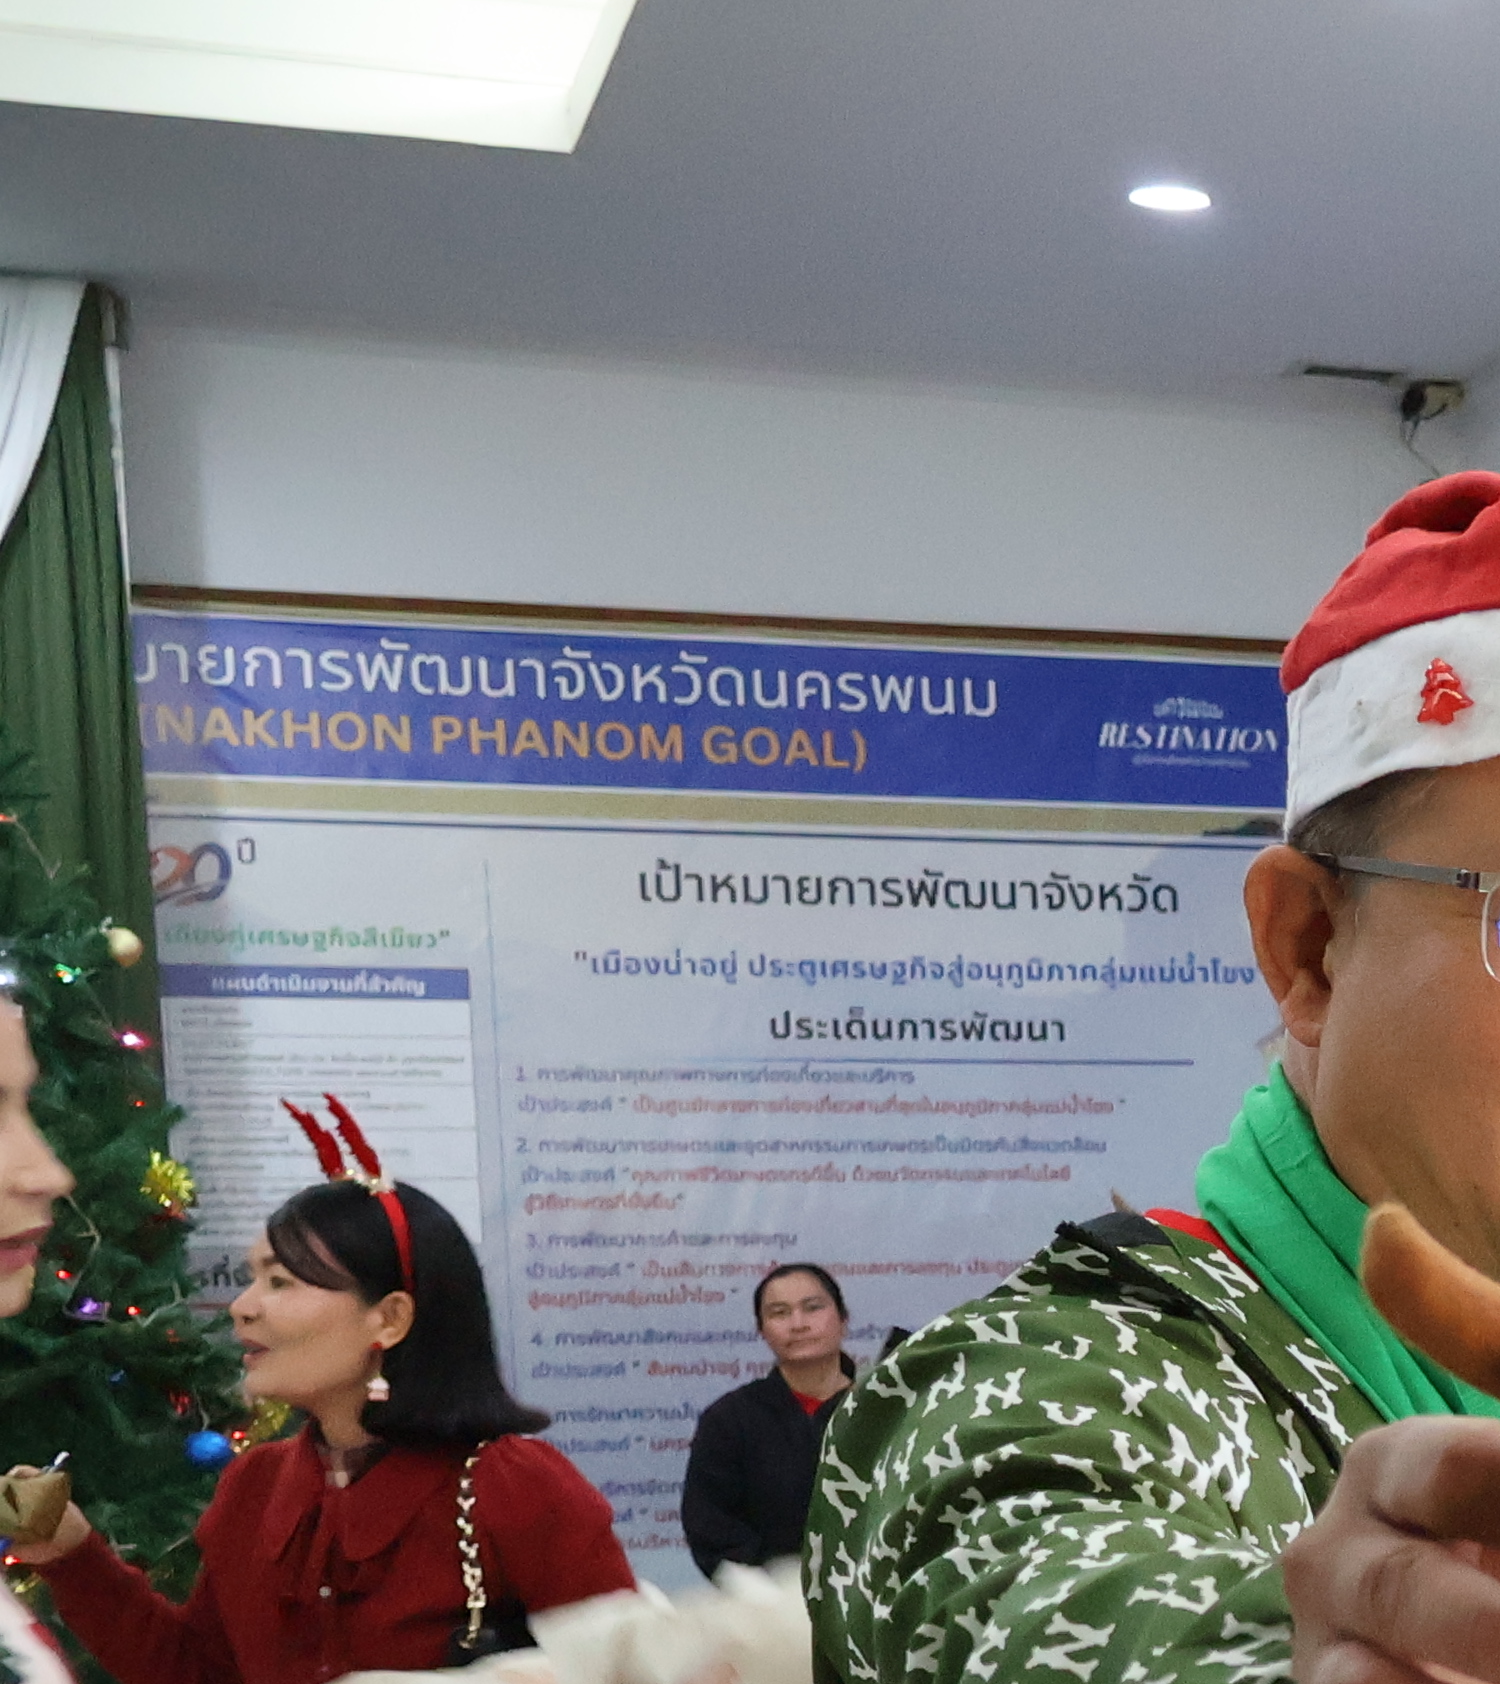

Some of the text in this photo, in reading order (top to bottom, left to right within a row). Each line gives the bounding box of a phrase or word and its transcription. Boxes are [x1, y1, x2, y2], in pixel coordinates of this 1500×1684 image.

[431, 714, 685, 763] PHANOM
[703, 723, 869, 773] GOAL)
[638, 856, 1180, 914] เป้าหมายการพัฒนาจังหวัด
[769, 1005, 1067, 1042] ประเด็นการพัฒนา
